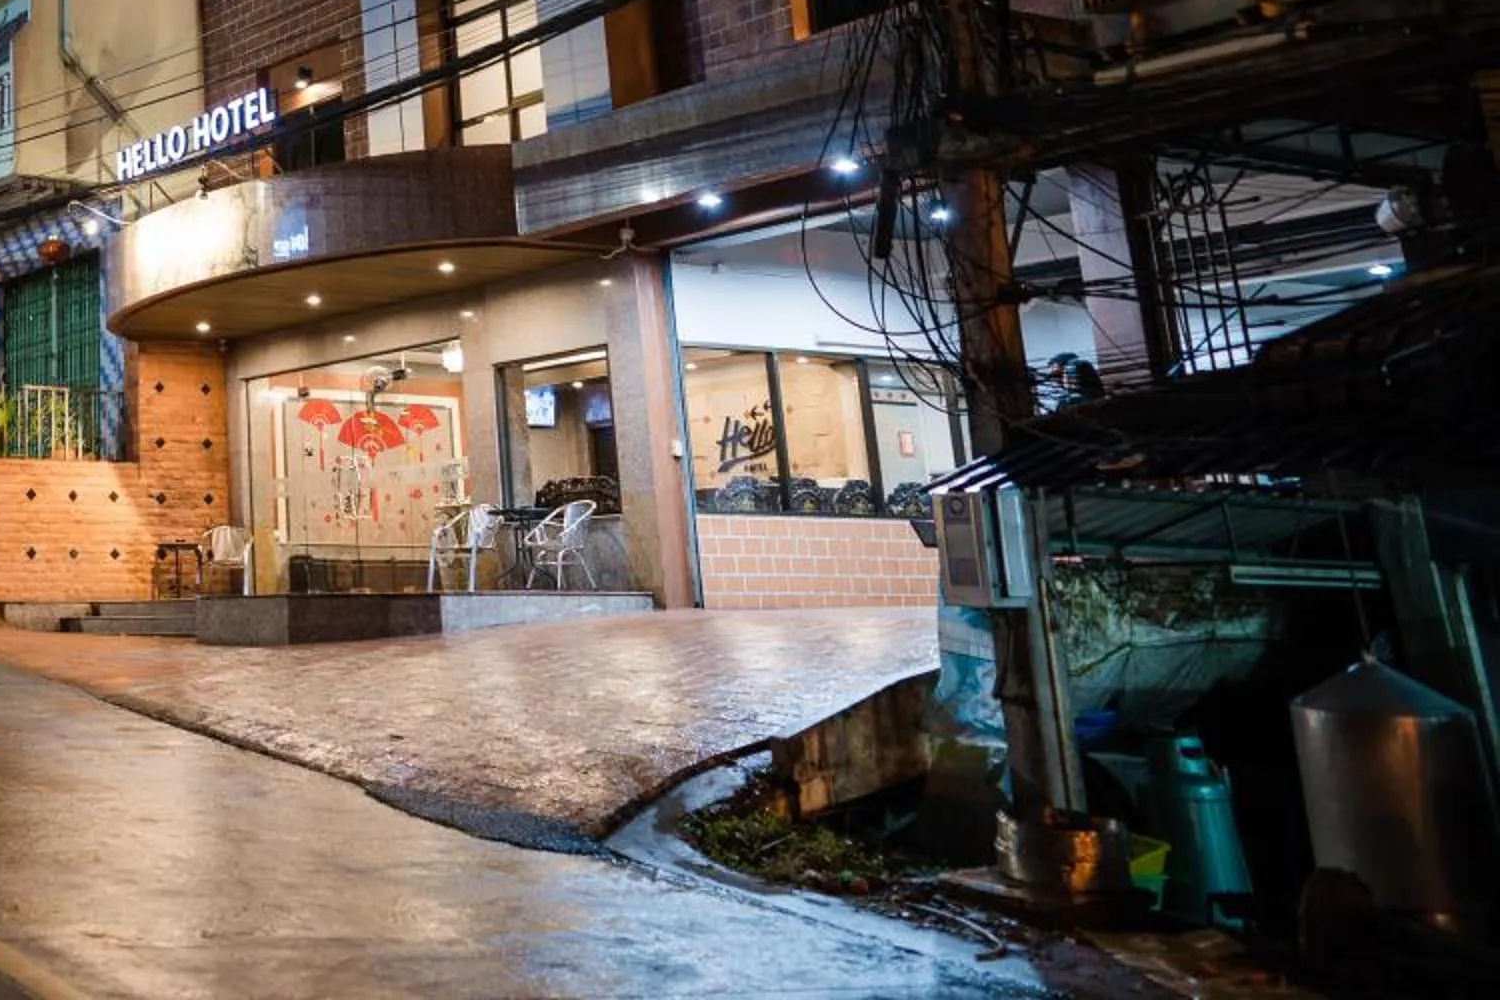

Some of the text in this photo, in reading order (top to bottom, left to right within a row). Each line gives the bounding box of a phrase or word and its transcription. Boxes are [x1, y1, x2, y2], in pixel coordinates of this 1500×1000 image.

[116, 88, 275, 181] HELLO HOTEL
[715, 416, 776, 462] Hello
